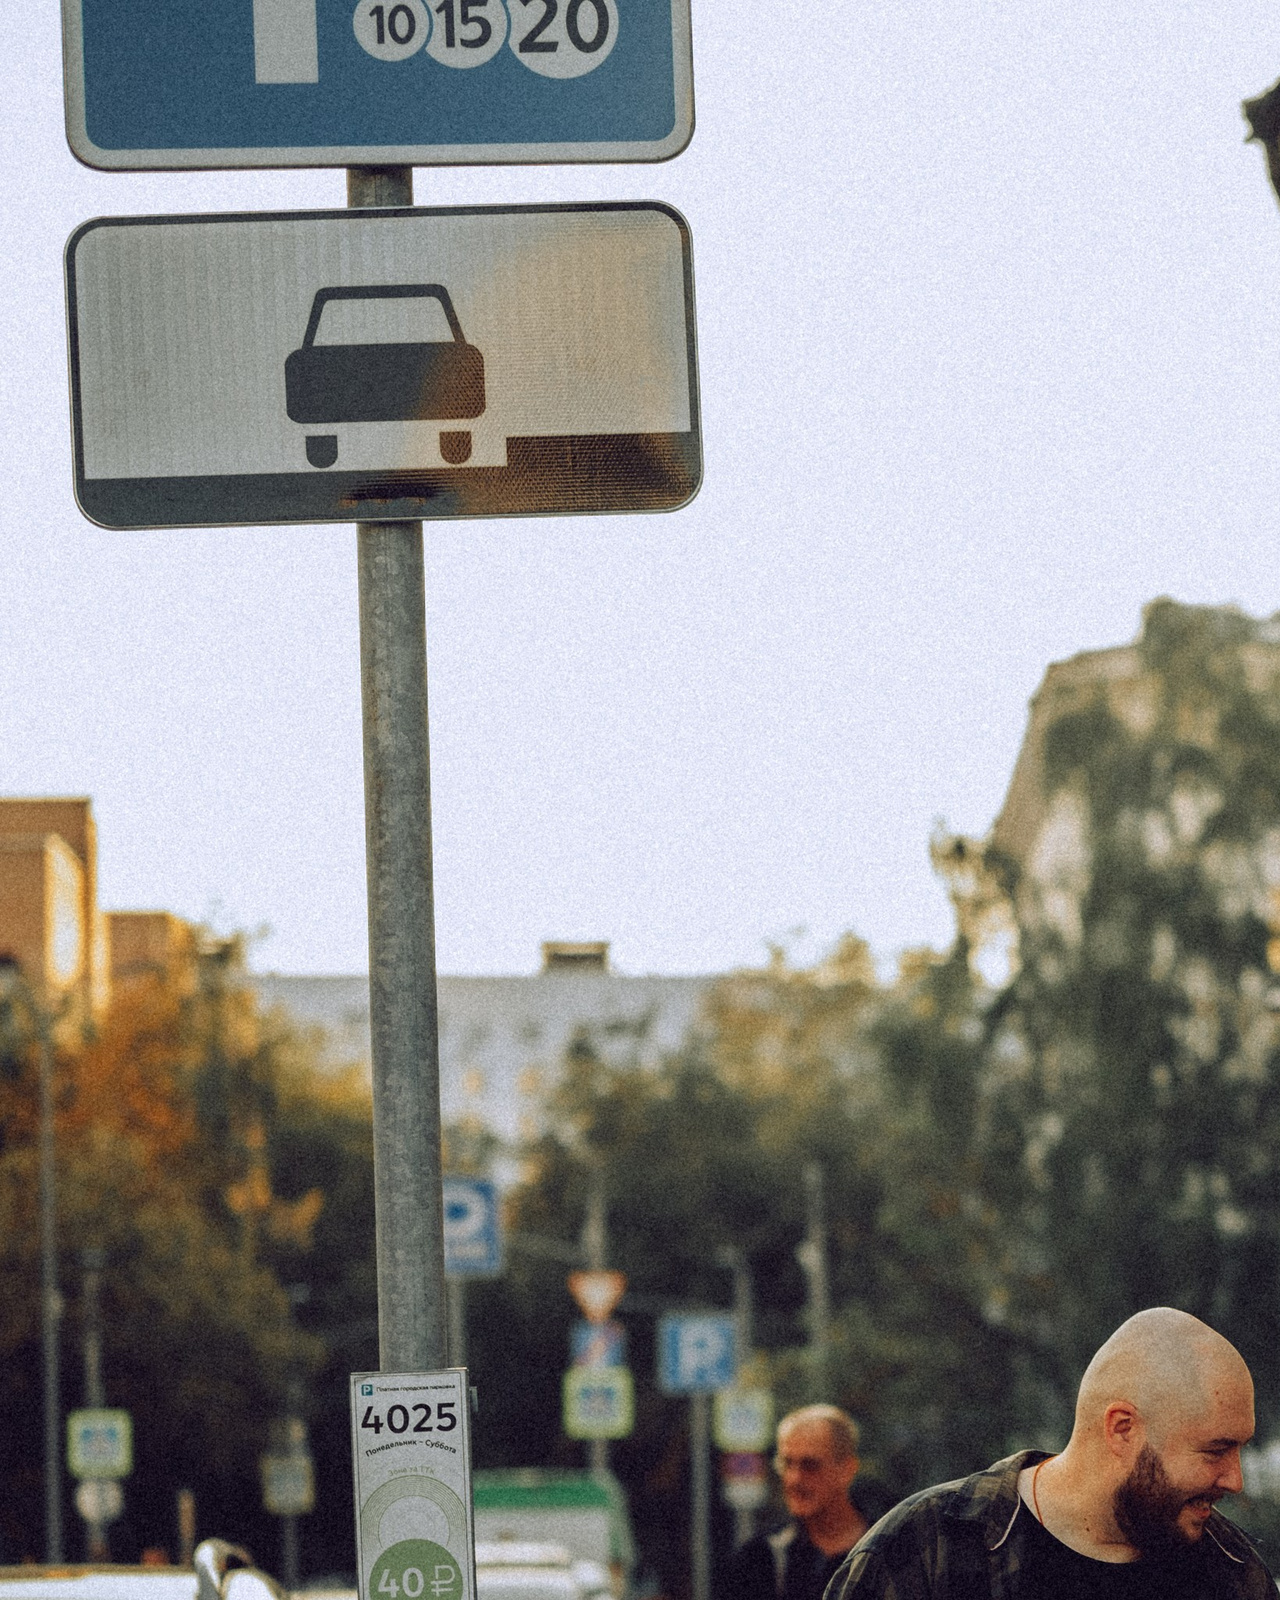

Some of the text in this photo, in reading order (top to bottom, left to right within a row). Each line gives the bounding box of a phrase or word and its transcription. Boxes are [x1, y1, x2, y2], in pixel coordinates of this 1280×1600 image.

[369, 4, 416, 45] 10
[435, 0, 492, 49] 15
[518, 0, 609, 54] 20
[361, 1402, 457, 1434] 4025
[365, 1440, 417, 1457] Понедельник
[425, 1440, 457, 1454] Суббота
[378, 1567, 424, 1598] 40
